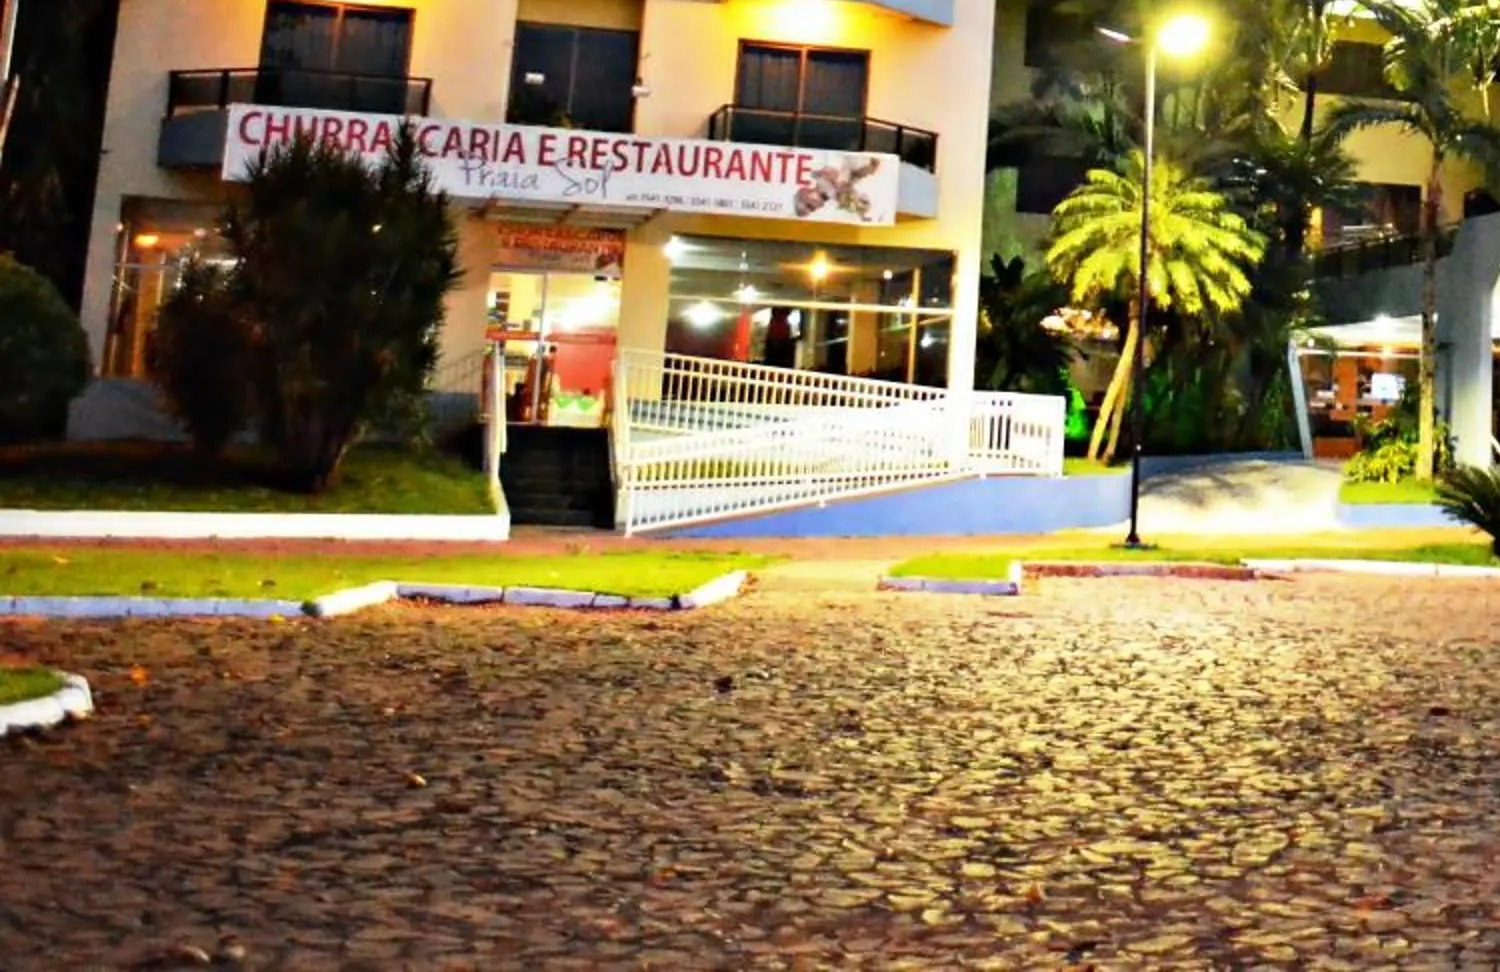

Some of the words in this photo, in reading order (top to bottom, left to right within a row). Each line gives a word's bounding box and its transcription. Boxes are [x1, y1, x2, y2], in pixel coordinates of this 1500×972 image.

[239, 110, 526, 165] CHURRACARIA
[538, 133, 558, 167] E
[567, 134, 814, 187] RESTAURANTE
[457, 150, 540, 190] Praia
[554, 157, 615, 199] Sol
